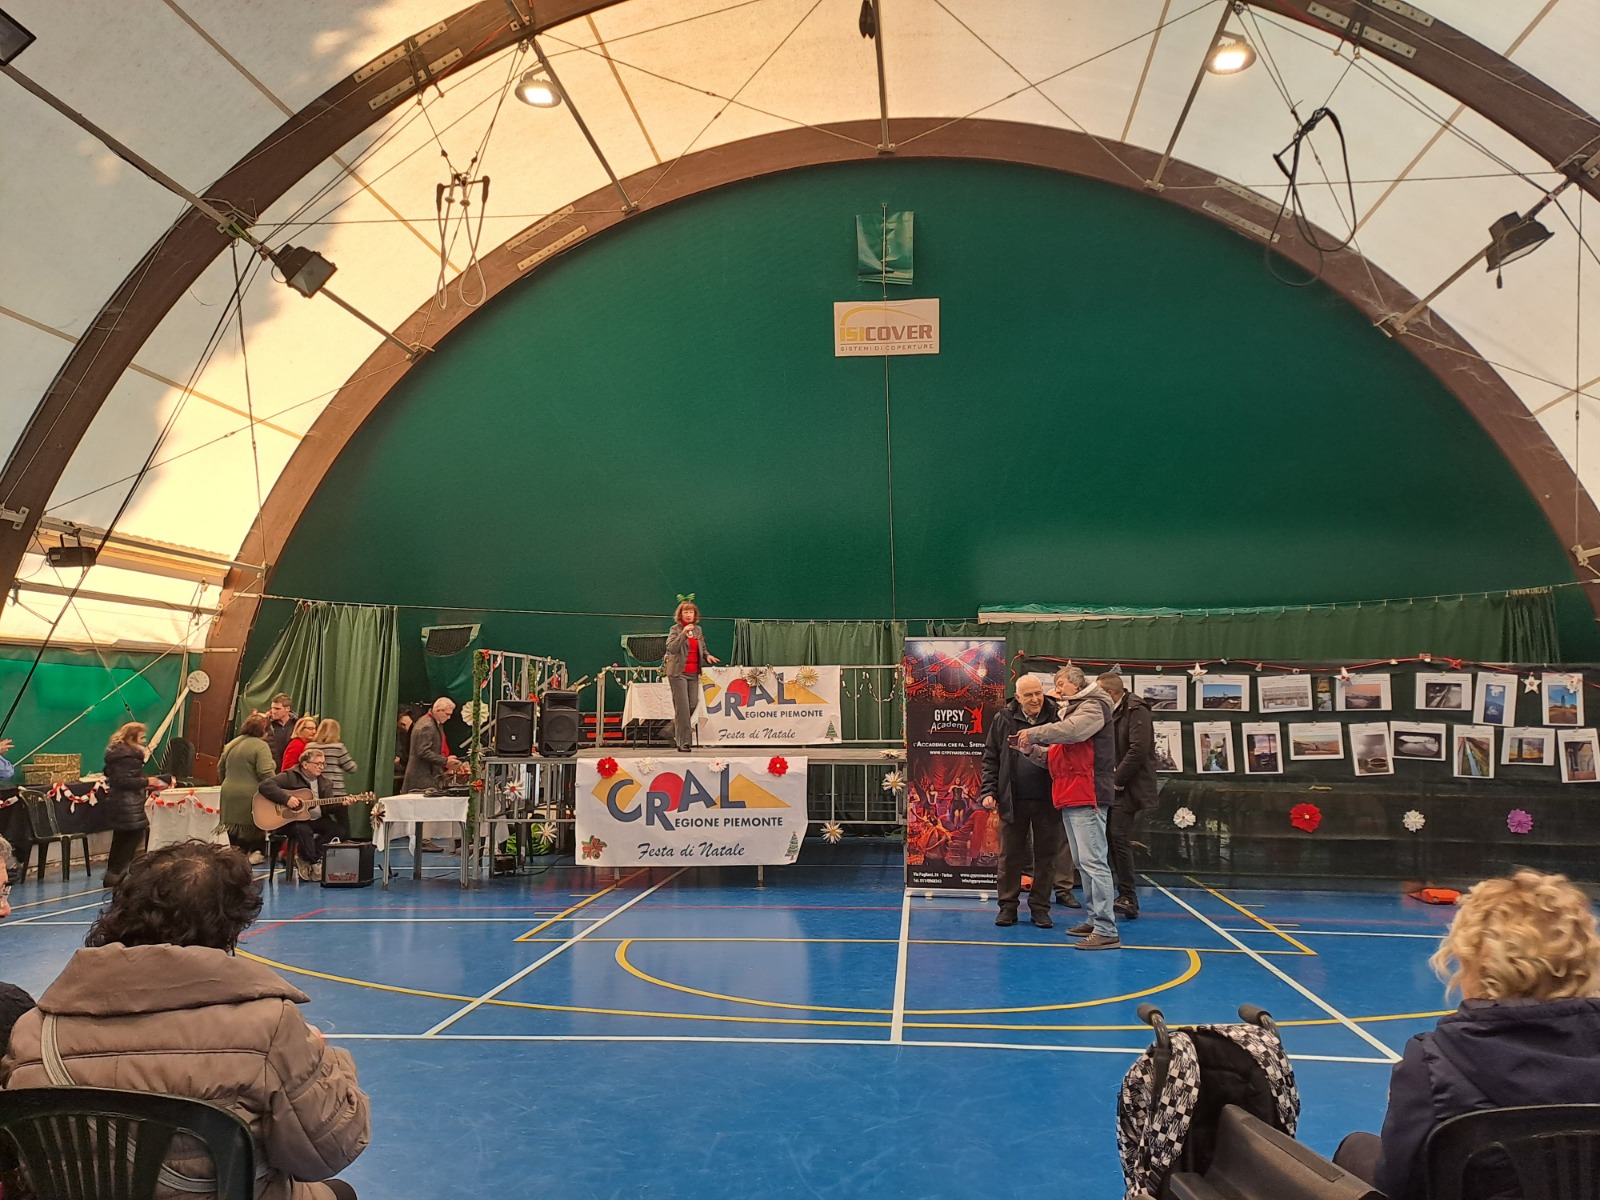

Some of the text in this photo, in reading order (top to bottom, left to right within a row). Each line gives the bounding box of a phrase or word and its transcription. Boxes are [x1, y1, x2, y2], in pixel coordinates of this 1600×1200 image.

[703, 672, 797, 720] CRAL
[781, 710, 823, 718] PIEMONTE
[934, 709, 965, 722] GYPSY
[718, 728, 796, 741] Festa di Natale
[930, 721, 969, 735] Academy
[607, 763, 747, 831] CRAL
[724, 817, 783, 827] PIEMONTE
[637, 842, 745, 859] Festa di Natale
